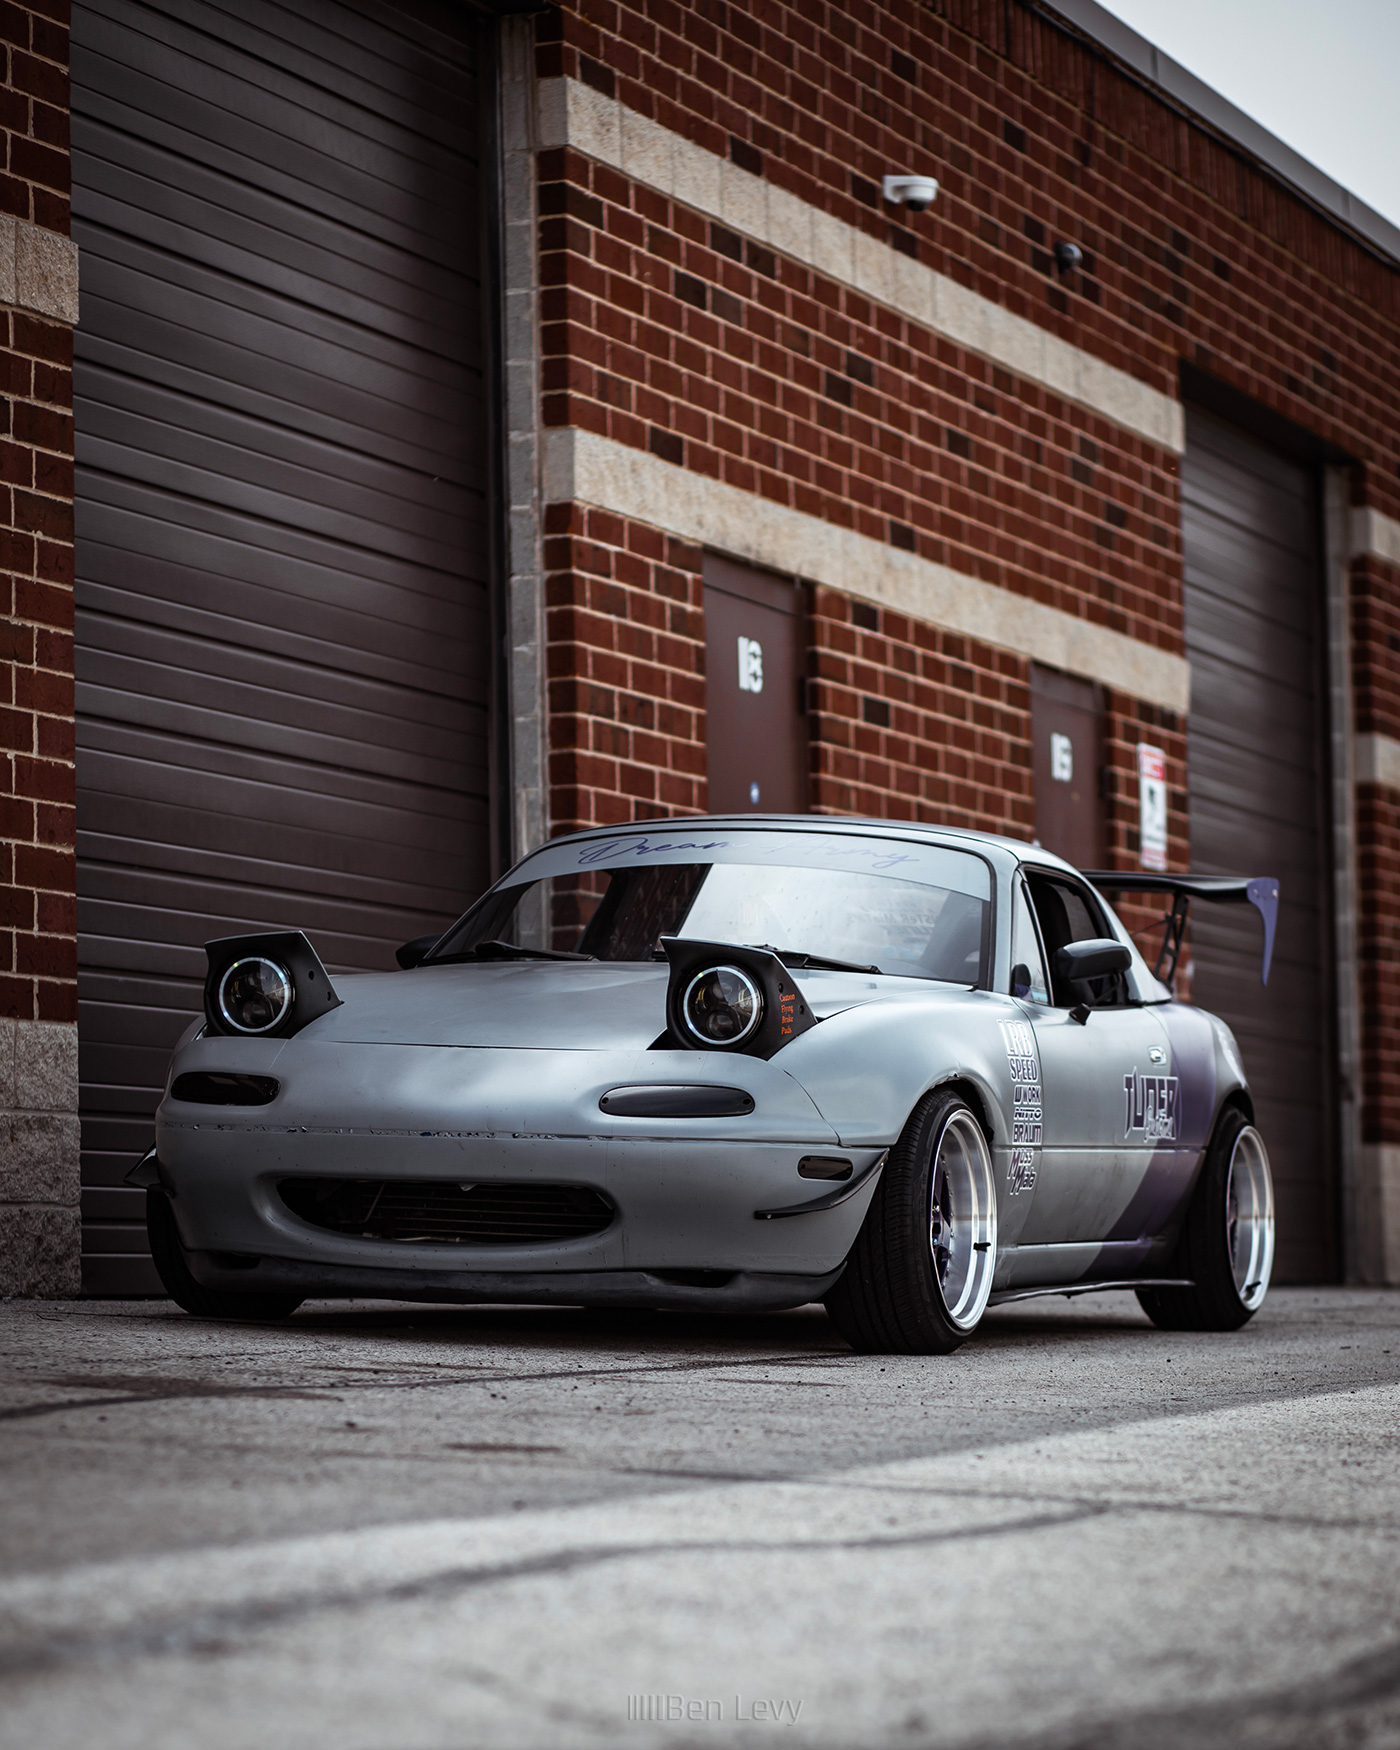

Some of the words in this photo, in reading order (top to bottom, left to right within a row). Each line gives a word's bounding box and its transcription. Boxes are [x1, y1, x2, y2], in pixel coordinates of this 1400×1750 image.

[578, 837, 748, 865] Dream
[781, 1014, 794, 1024] Brake
[781, 1025, 792, 1035] Pads
[997, 1019, 1034, 1057] LRB
[1009, 1058, 1038, 1083] SPEED
[1014, 1107, 1042, 1121] NITTO
[1124, 1066, 1178, 1139] TUNER
